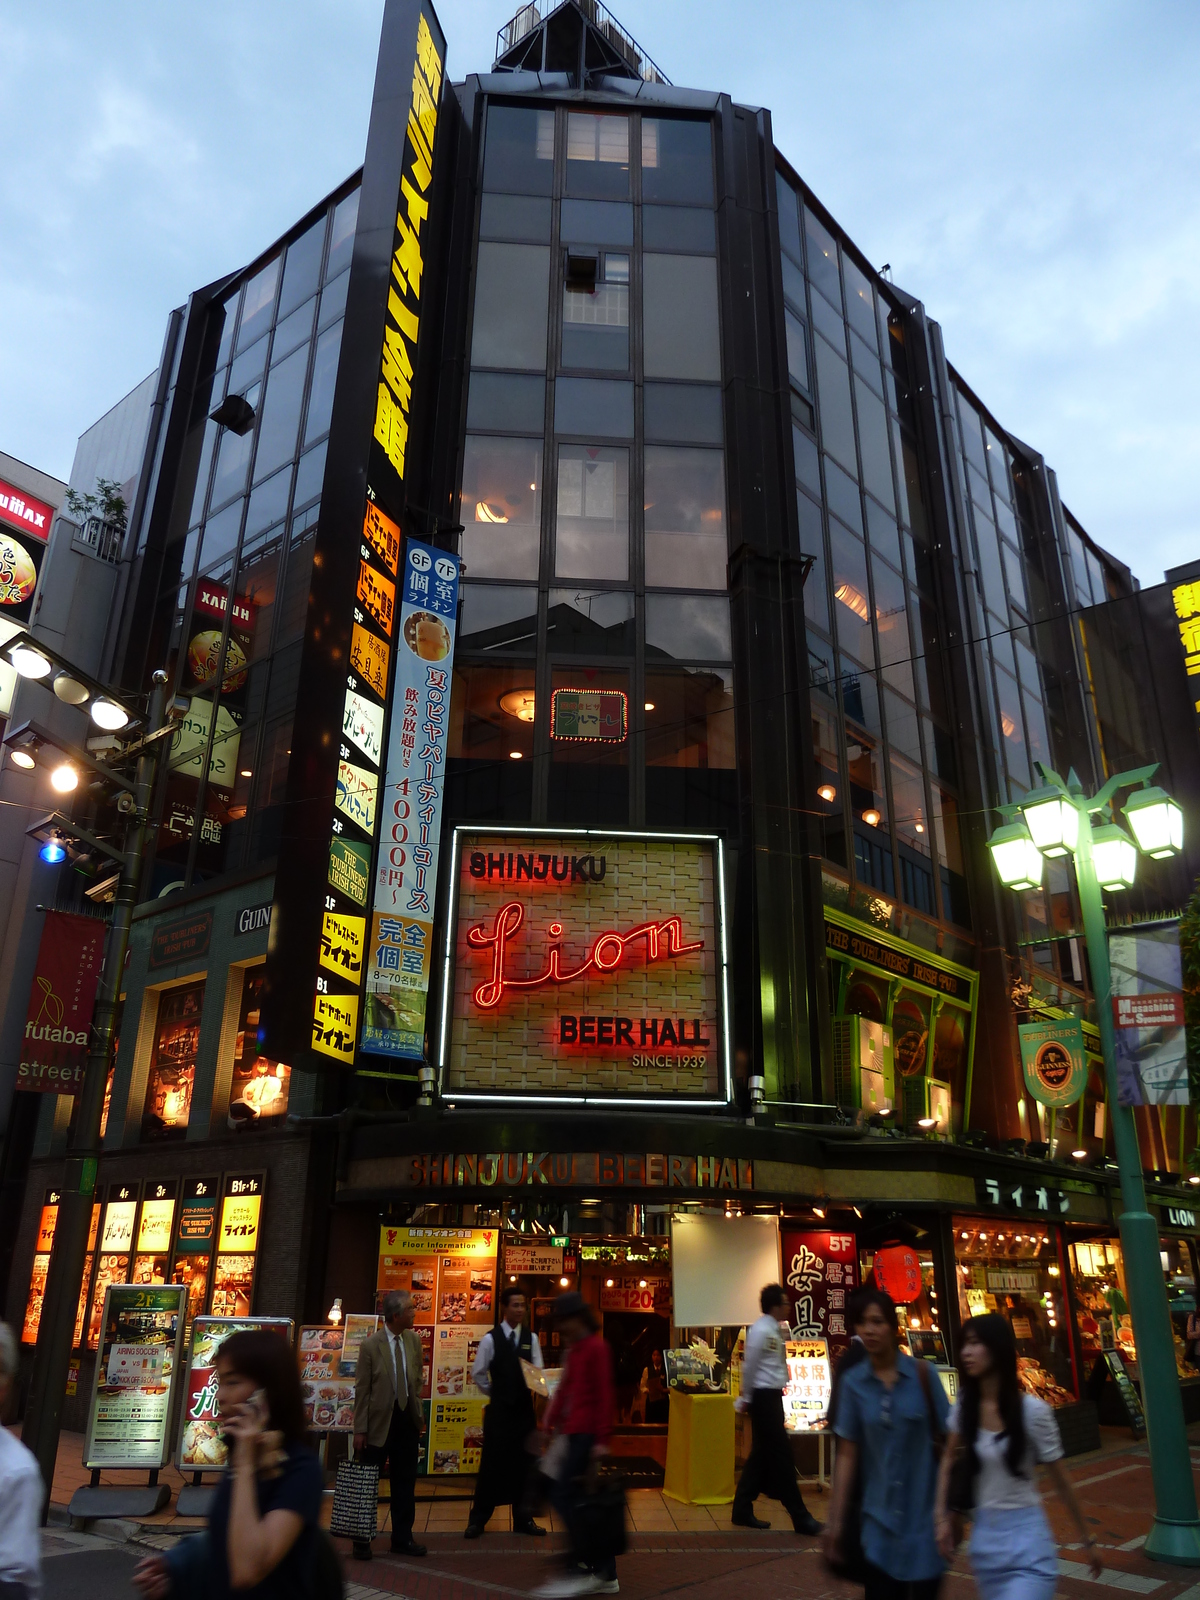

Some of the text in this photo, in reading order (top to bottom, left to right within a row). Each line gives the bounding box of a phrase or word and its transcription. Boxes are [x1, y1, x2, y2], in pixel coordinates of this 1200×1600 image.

[366, 484, 376, 500] 7F
[360, 544, 370, 560] 6F
[411, 552, 455, 577] 6F 7F
[409, 570, 454, 603] 個室
[408, 592, 452, 613] ライオン
[353, 607, 364, 623] 5F
[346, 675, 358, 690] 4F
[400, 687, 420, 768] 飲み放題付き
[559, 711, 620, 726] ブルマーレ
[340, 744, 350, 760] 3F
[407, 666, 448, 912] 夏のビヤパーティーコース
[337, 780, 374, 828] ブルマーレ
[332, 818, 344, 834] 2F
[344, 849, 356, 868] THE
[468, 851, 606, 882] SHINJUKU
[332, 868, 363, 900] IRISH PUB
[325, 896, 336, 910] 1F
[157, 934, 168, 946] THE
[326, 916, 360, 946] ビヤレストラン
[378, 918, 426, 948] 完全
[164, 937, 196, 956] IRISH PUB
[320, 938, 362, 972] ライオン
[466, 902, 704, 1009] Lion
[376, 944, 424, 976] 個室
[826, 926, 849, 950] THE
[913, 962, 938, 987] IRISH
[939, 974, 958, 994] PUB
[316, 976, 328, 994] B1
[318, 1000, 352, 1028] ビヤホール
[1118, 999, 1174, 1014] Musashino
[25, 1020, 88, 1046] futaba
[312, 1021, 354, 1052] ライオン
[559, 1015, 710, 1048] BEER HALL
[18, 1060, 82, 1082] street
[632, 1053, 708, 1070] SINCE 1939
[1038, 1061, 1071, 1070] GUINNESS
[408, 1152, 573, 1187] SHINJUKU
[599, 1152, 688, 1187] BEER
[120, 1188, 130, 1198] 4F
[156, 1185, 166, 1197] 3F
[196, 1182, 208, 1194] 2F
[986, 1178, 1070, 1214] ライオン
[1168, 1208, 1195, 1227] LION
[224, 1224, 256, 1236] ライオン
[408, 1229, 472, 1238] 新宿ライオン会館
[829, 1236, 852, 1252] 5F
[135, 1292, 156, 1307] 2F
[826, 1262, 847, 1336] 居酒屋
[117, 1348, 159, 1356] AIRING SOCCER
[788, 1348, 825, 1358] ライオン
[130, 1376, 140, 1384] OFF
